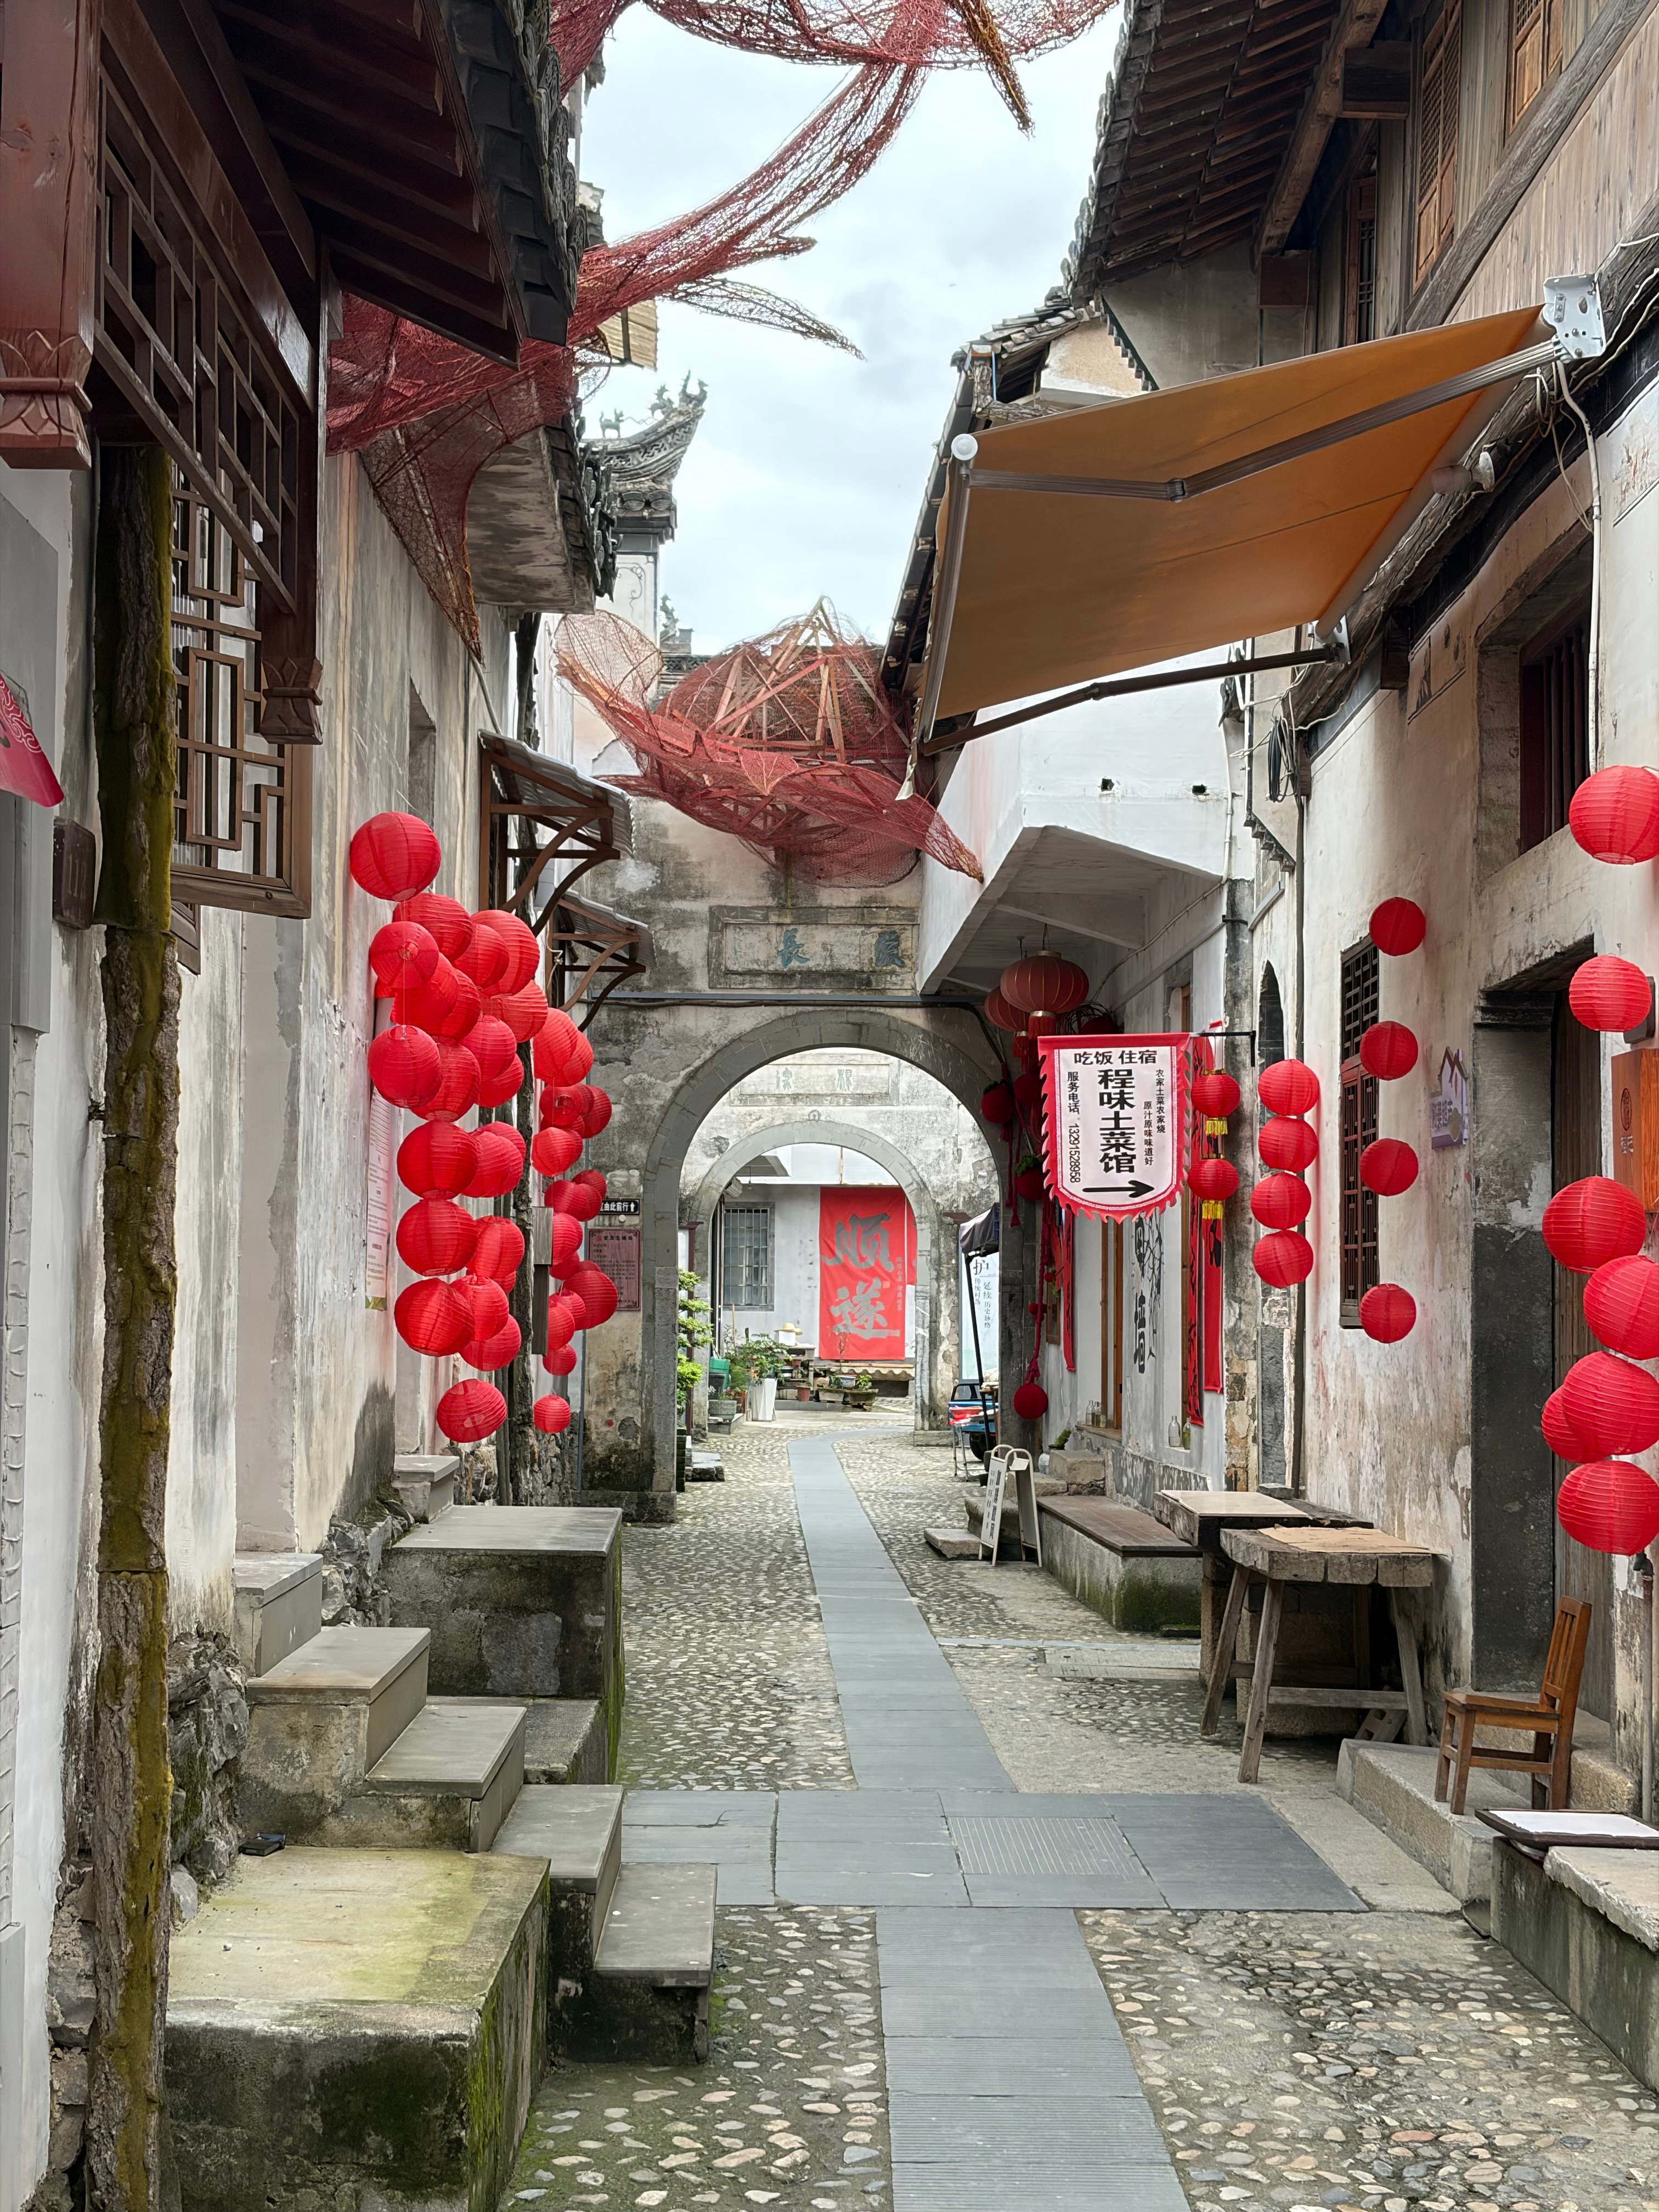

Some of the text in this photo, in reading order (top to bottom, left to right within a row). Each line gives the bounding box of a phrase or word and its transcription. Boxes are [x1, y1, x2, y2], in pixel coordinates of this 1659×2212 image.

[1074, 1049, 1157, 1065] 吃饭 住宿
[1098, 1068, 1136, 1173] 程味土菜馆
[1155, 1069, 1166, 1133] 农家土菜农家烧
[1143, 1101, 1154, 1166] 原汁原味味道好
[973, 1259, 989, 1276] 护
